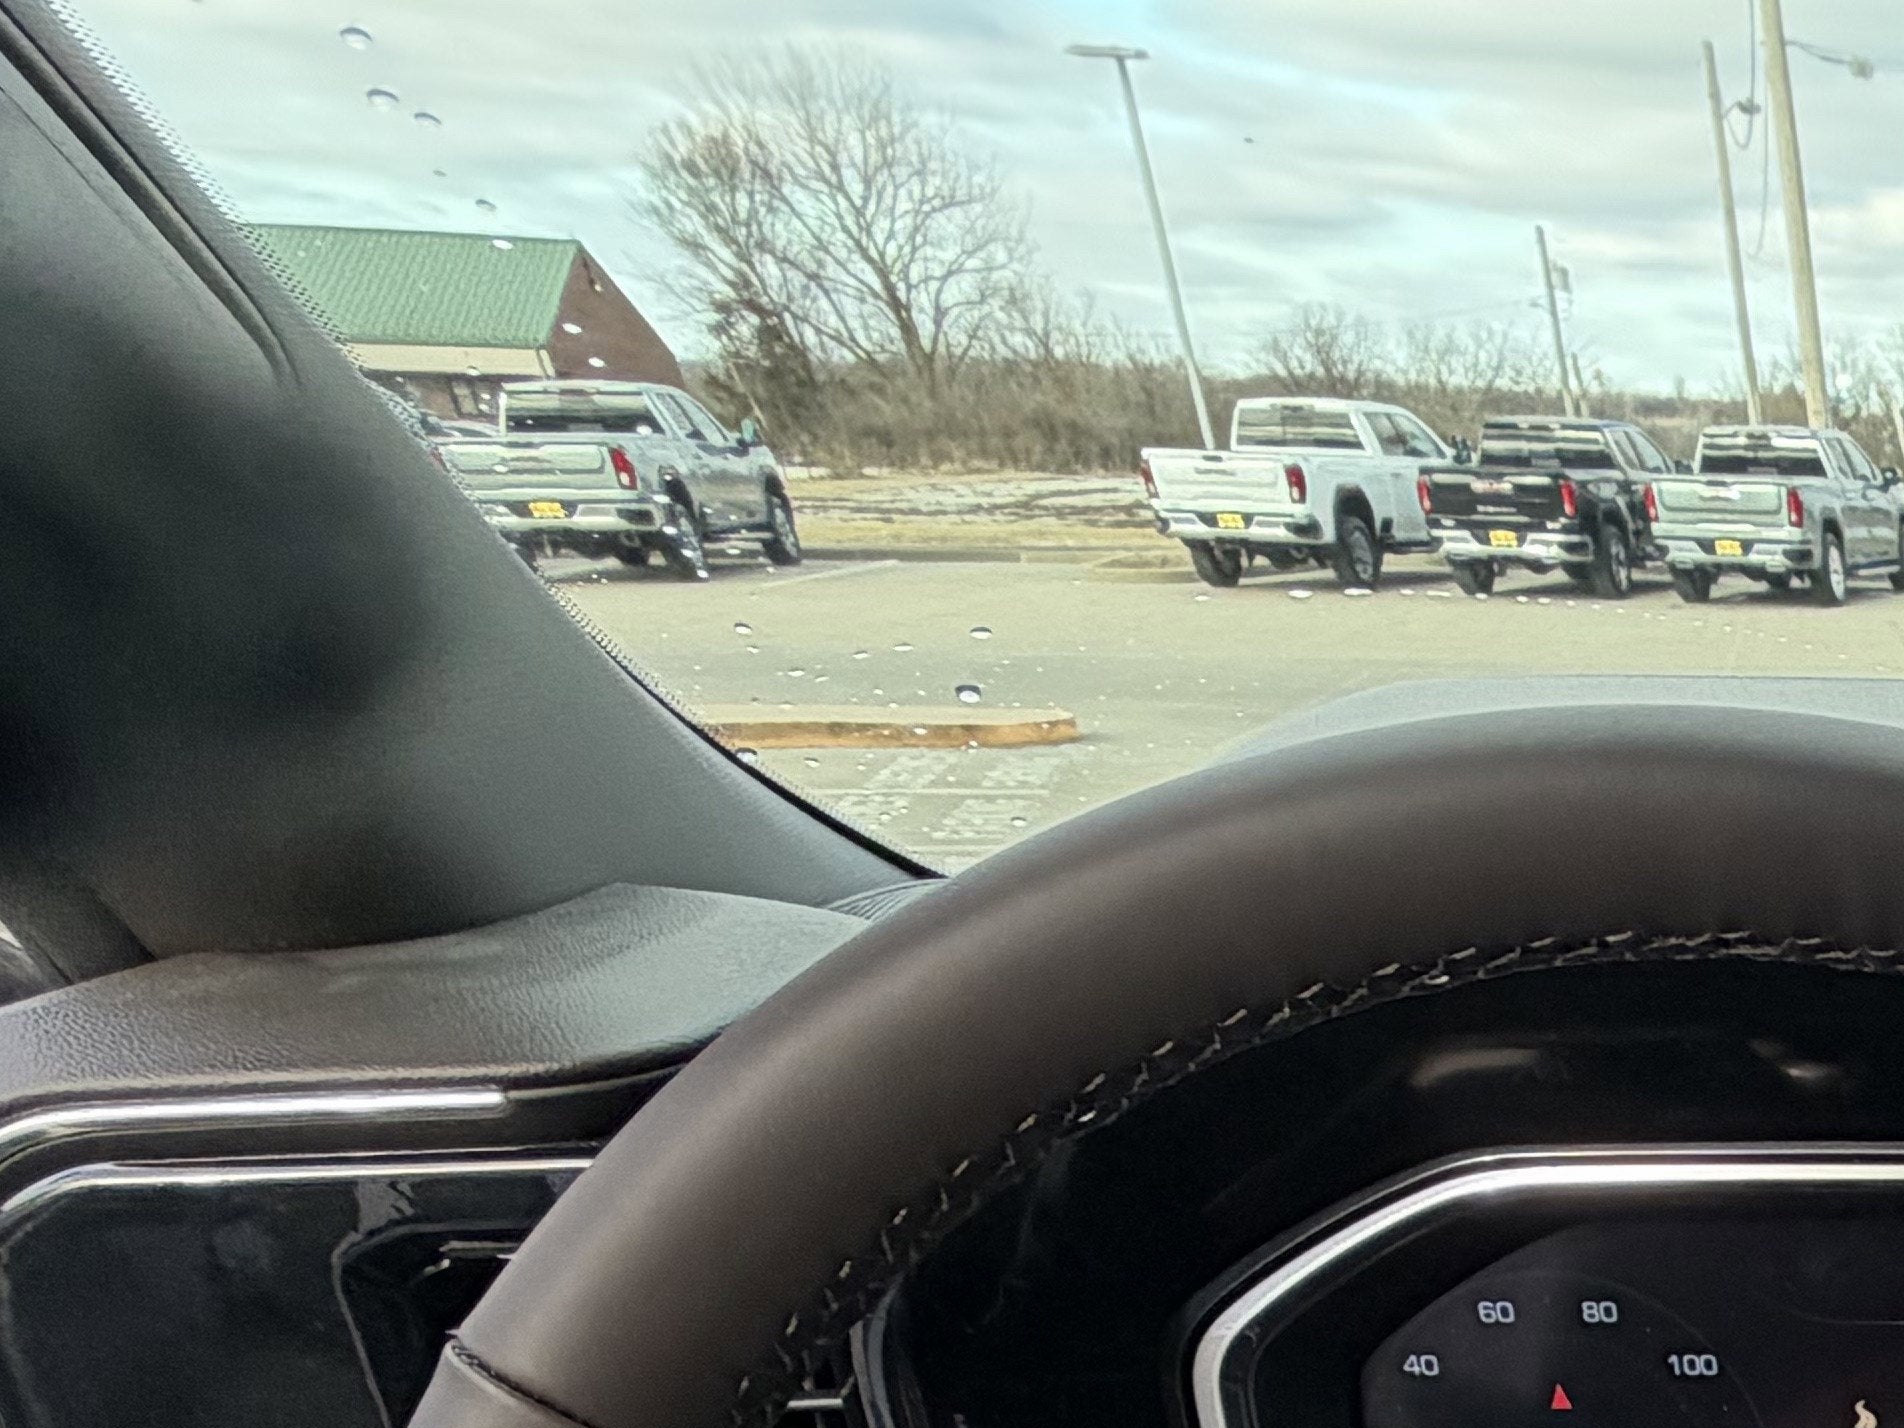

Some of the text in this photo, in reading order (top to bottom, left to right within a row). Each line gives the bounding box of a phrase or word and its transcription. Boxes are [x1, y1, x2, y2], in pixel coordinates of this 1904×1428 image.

[1477, 1301, 1515, 1324] 60
[1581, 1301, 1618, 1324] 80
[1402, 1353, 1440, 1377] 40
[1668, 1353, 1719, 1377] 100
